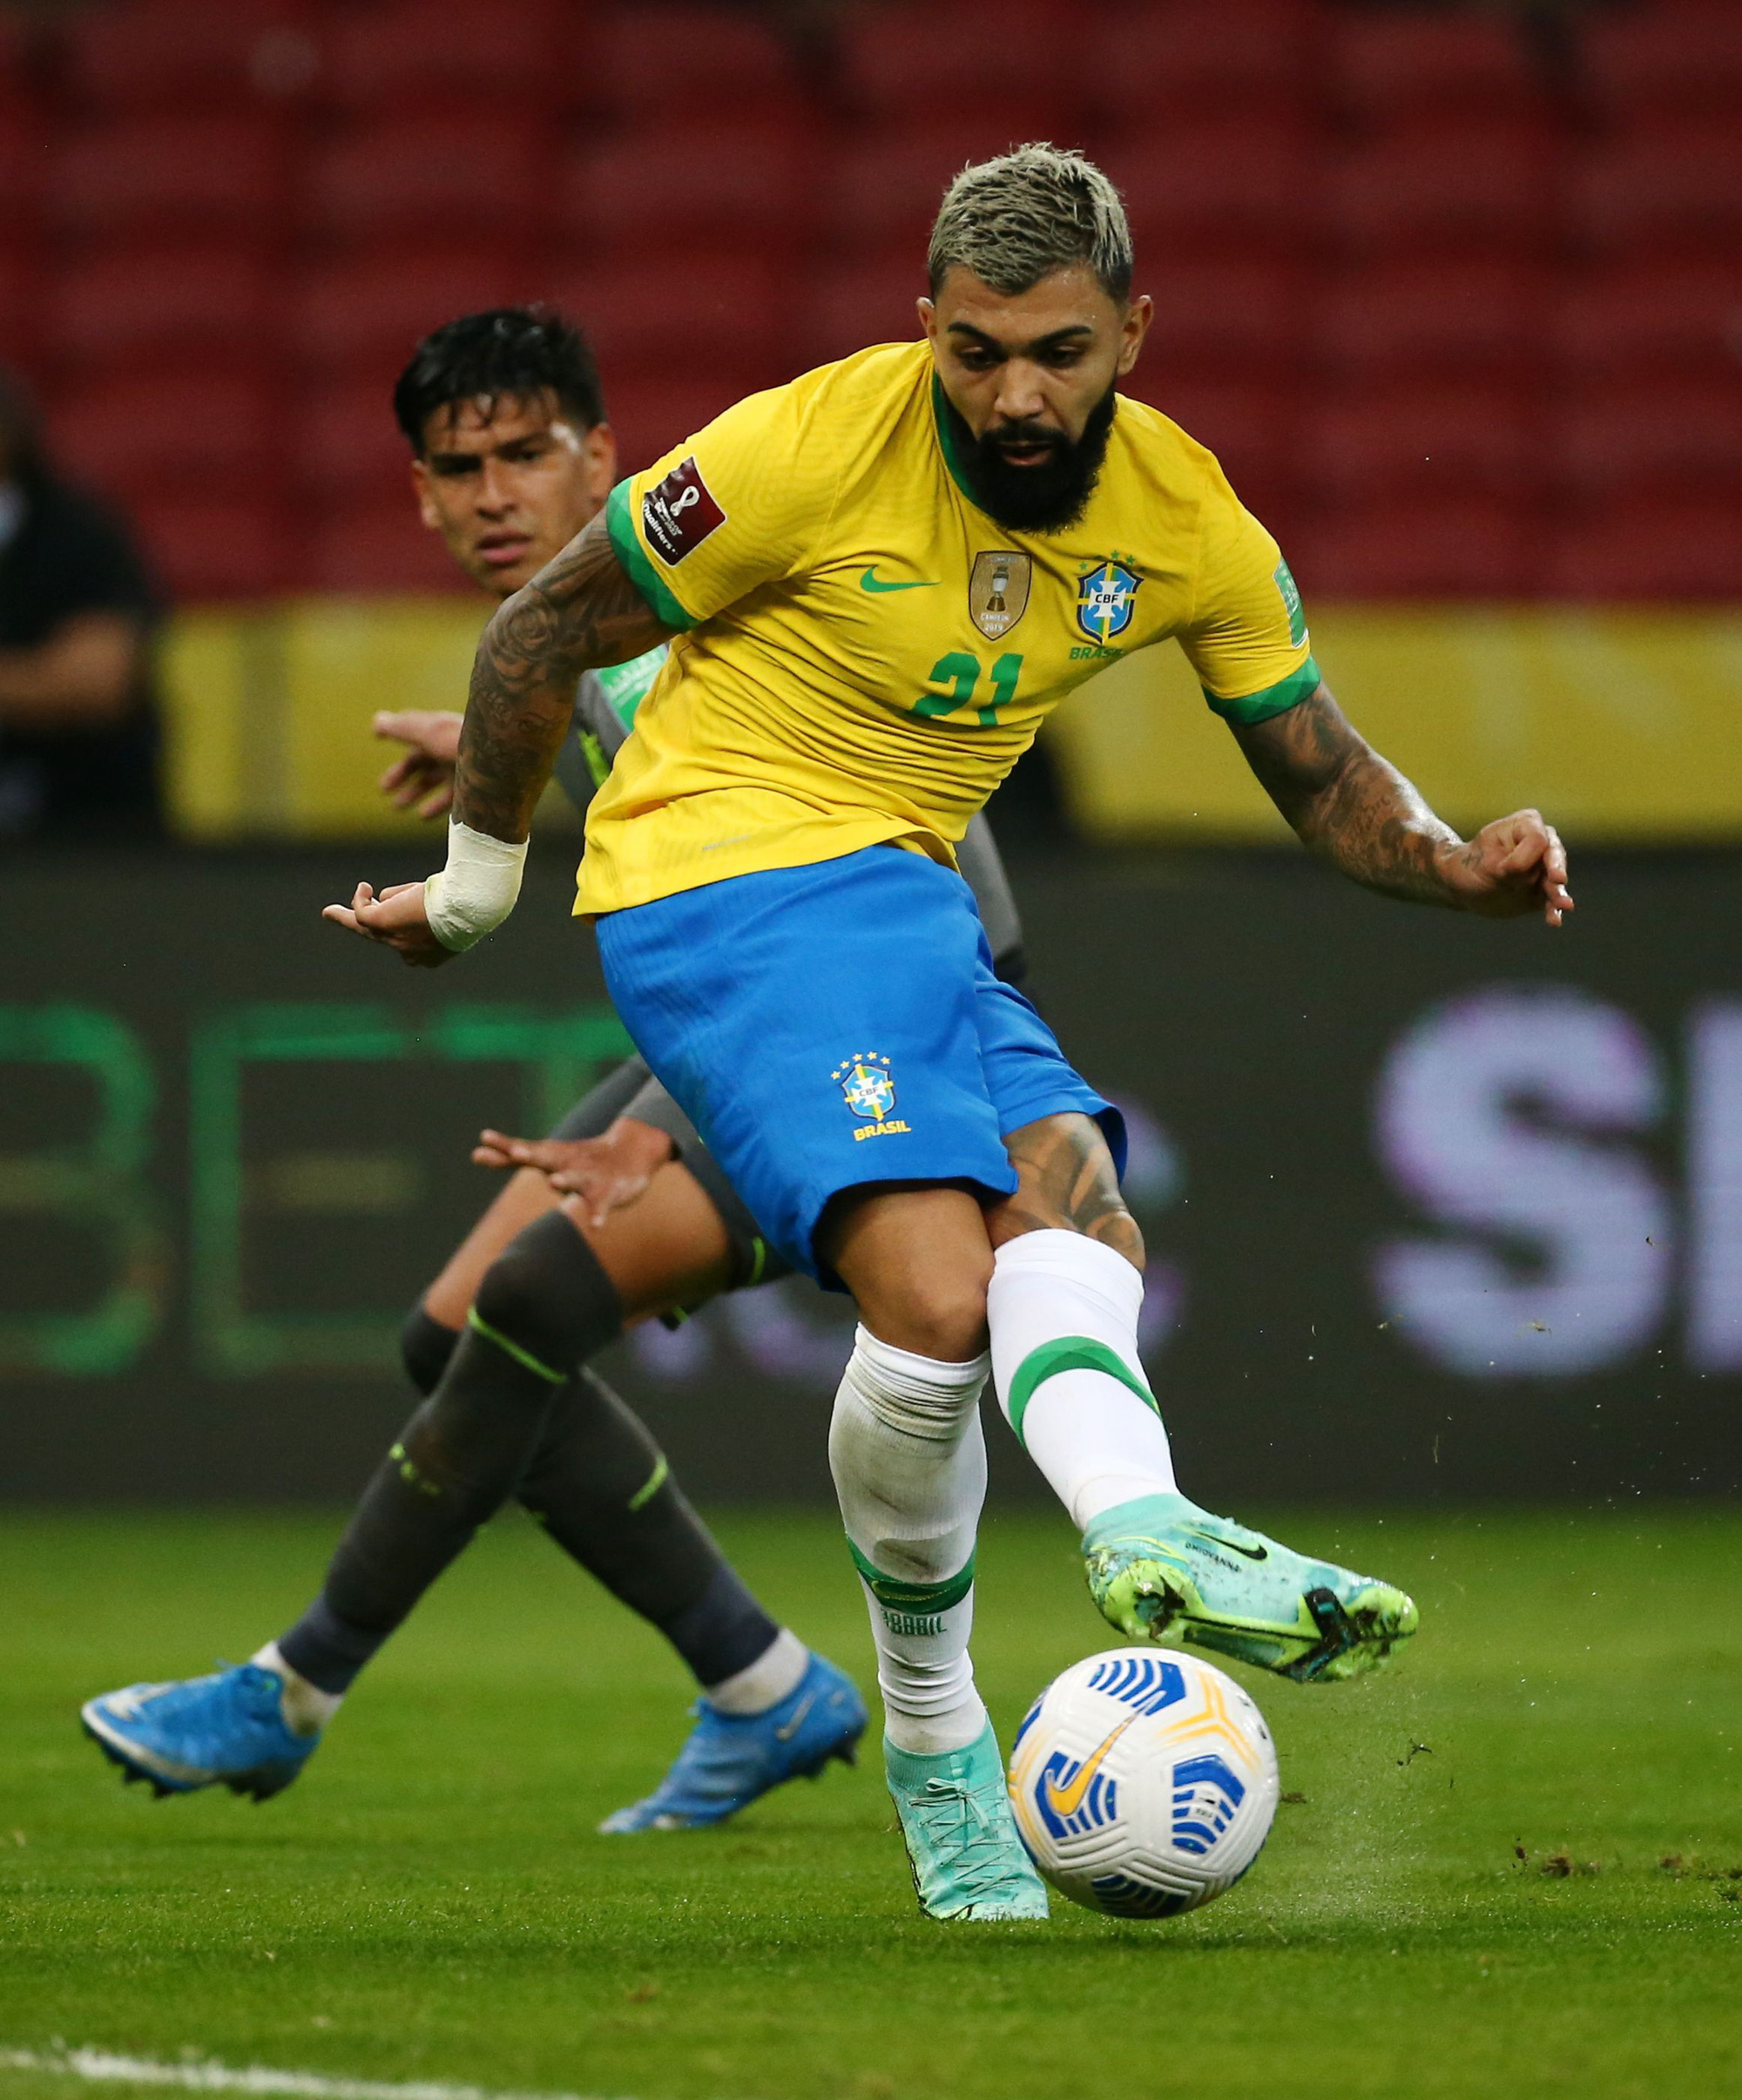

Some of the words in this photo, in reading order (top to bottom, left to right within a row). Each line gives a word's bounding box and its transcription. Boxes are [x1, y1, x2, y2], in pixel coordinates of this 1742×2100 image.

[1096, 593, 1119, 604] CBF
[912, 652, 1024, 726] 21
[859, 1087, 878, 1097] CBF
[854, 1120, 912, 1142] BRASIL
